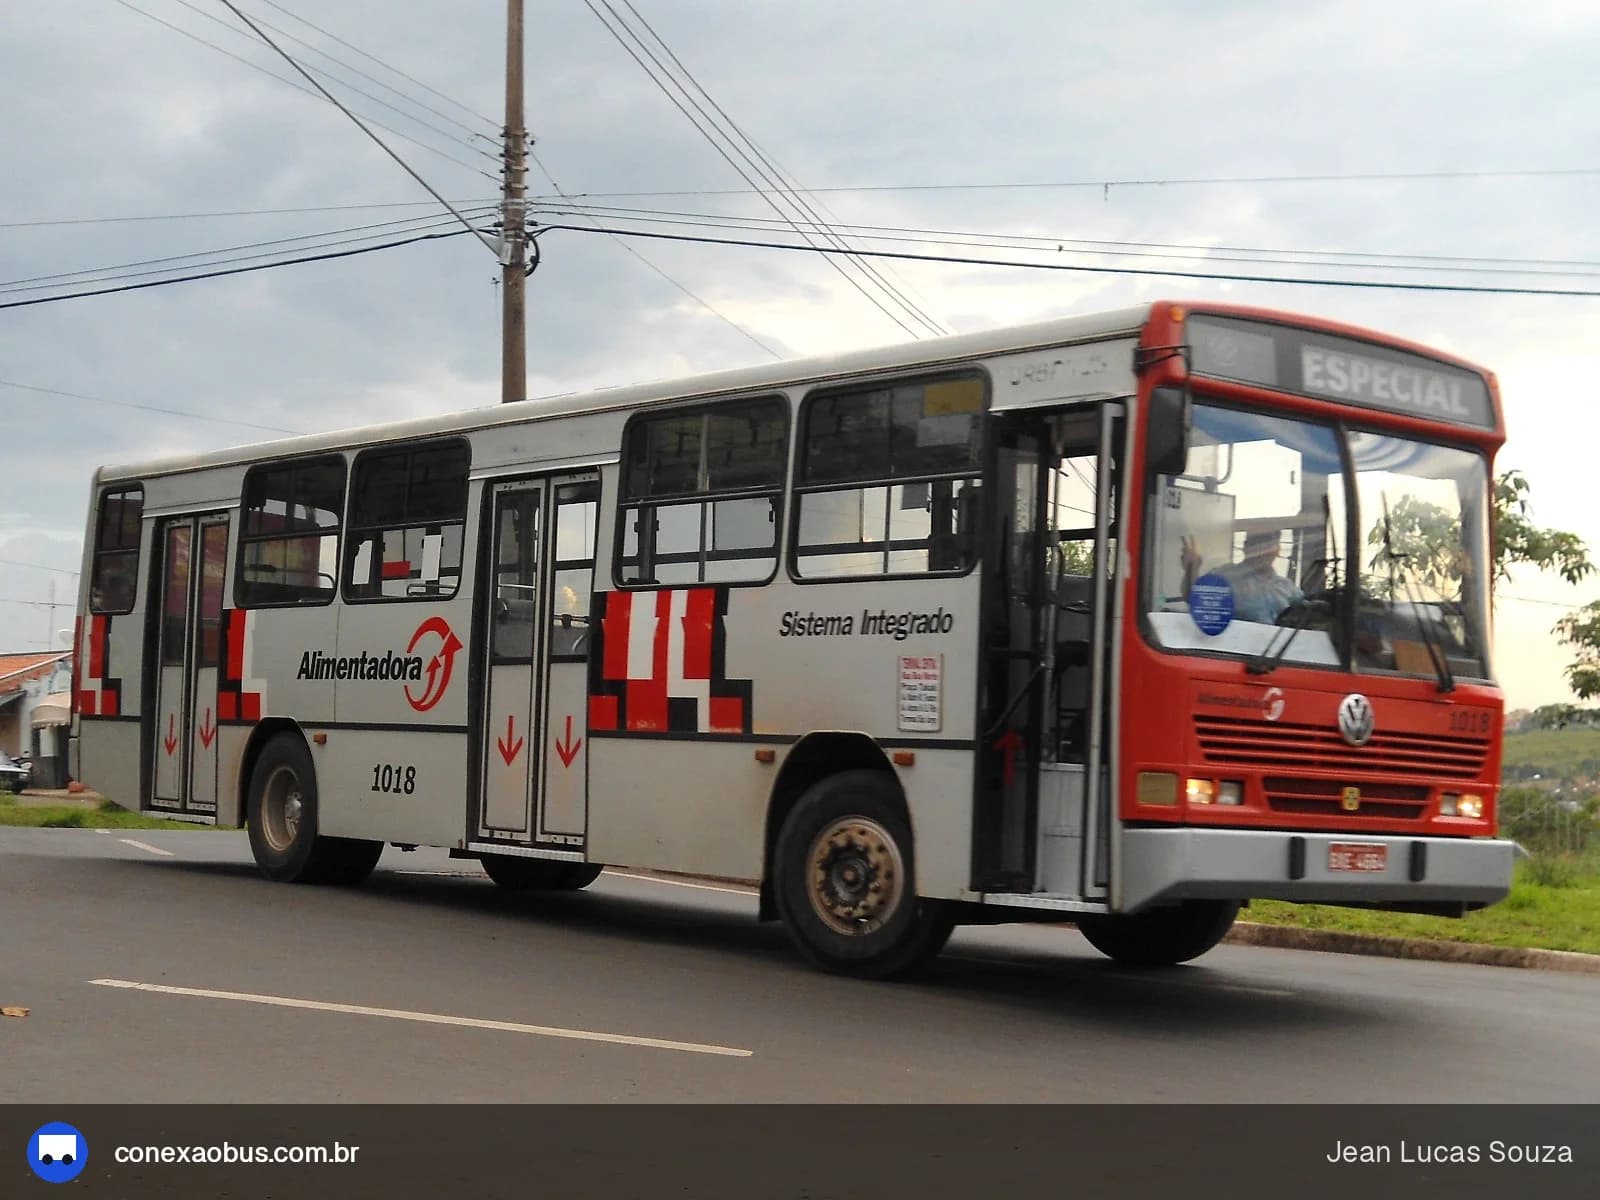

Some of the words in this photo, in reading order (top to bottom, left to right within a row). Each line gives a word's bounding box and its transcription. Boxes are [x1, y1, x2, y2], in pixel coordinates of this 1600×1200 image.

[1302, 350, 1471, 416] ESPECIAL
[779, 610, 854, 638] Sistema
[860, 606, 954, 641] Integrado
[296, 650, 423, 681] Alimentadora
[1449, 710, 1490, 733] 1018
[371, 763, 417, 795] 1018
